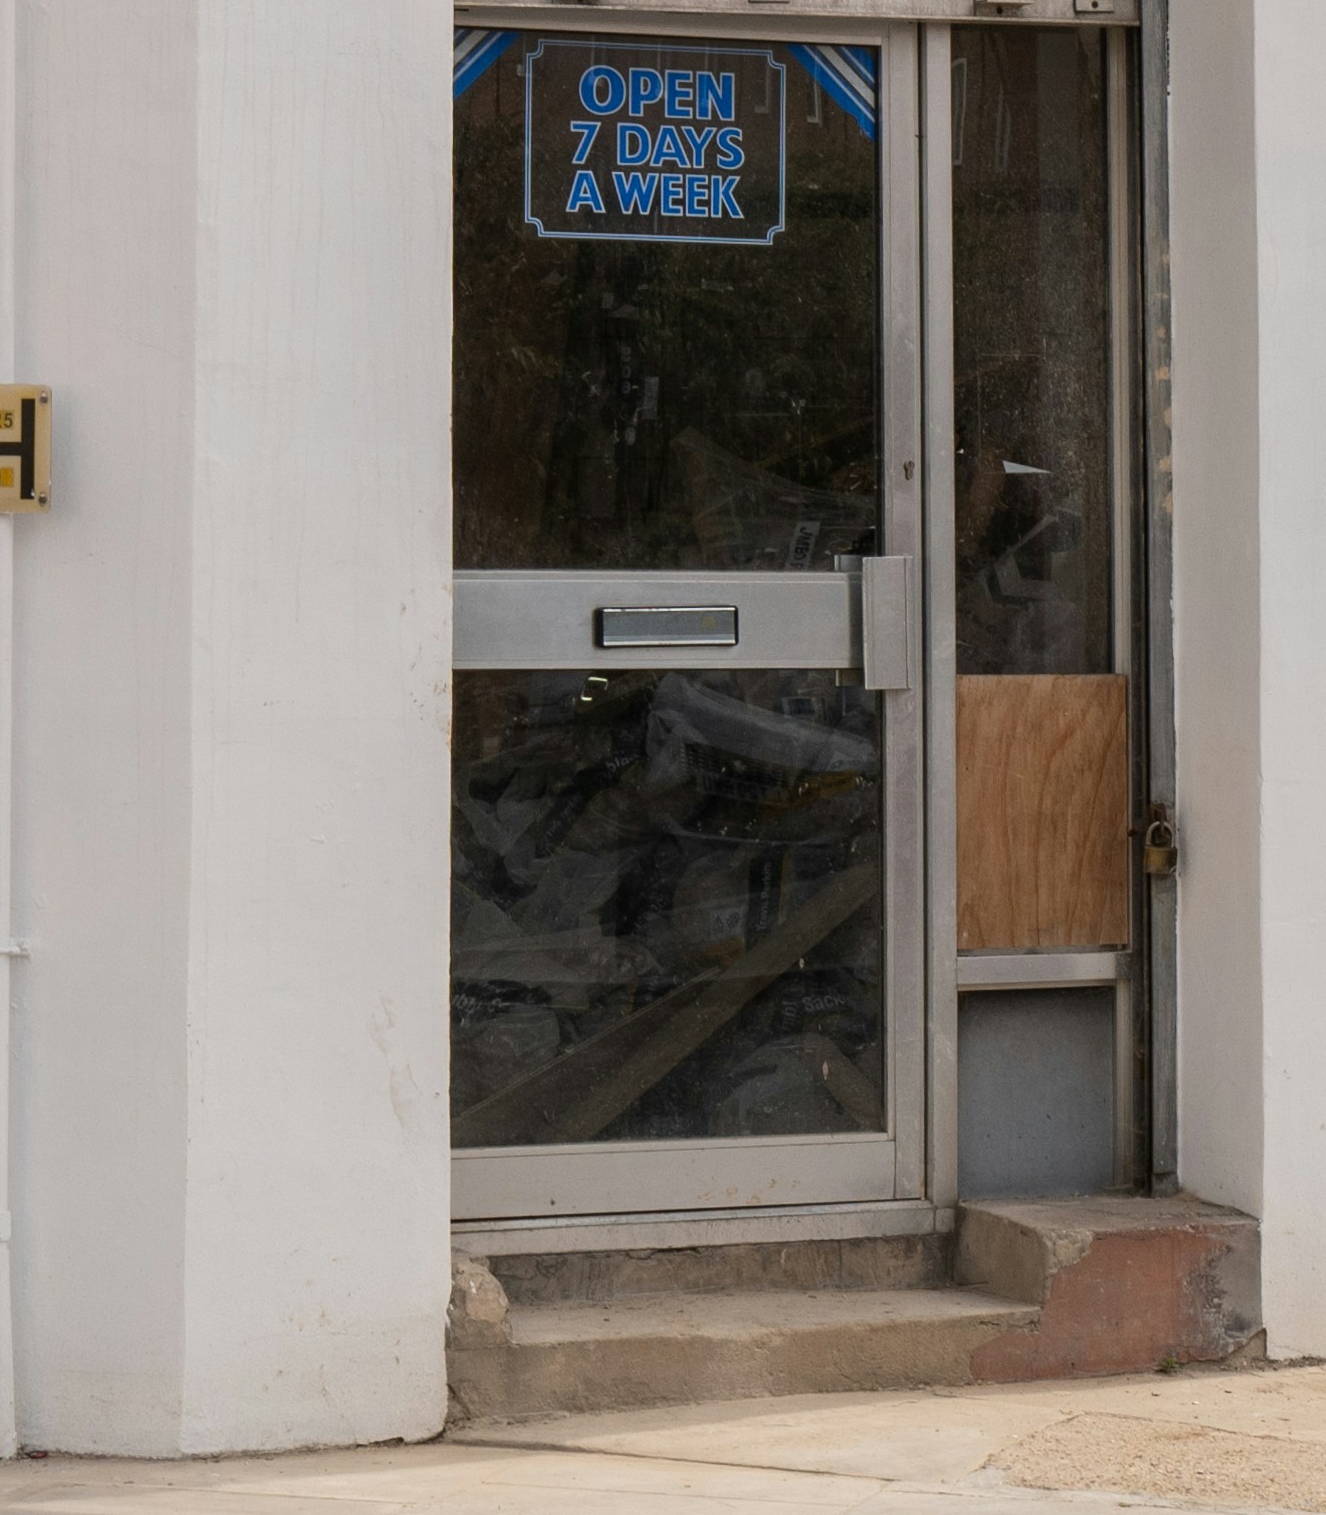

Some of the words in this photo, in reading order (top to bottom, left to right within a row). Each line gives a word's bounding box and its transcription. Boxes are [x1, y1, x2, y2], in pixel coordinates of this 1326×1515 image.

[579, 64, 736, 122] OPEN
[570, 120, 601, 165] 7
[616, 122, 745, 170] DAYS
[565, 169, 606, 214] A
[611, 171, 745, 219] WEEK
